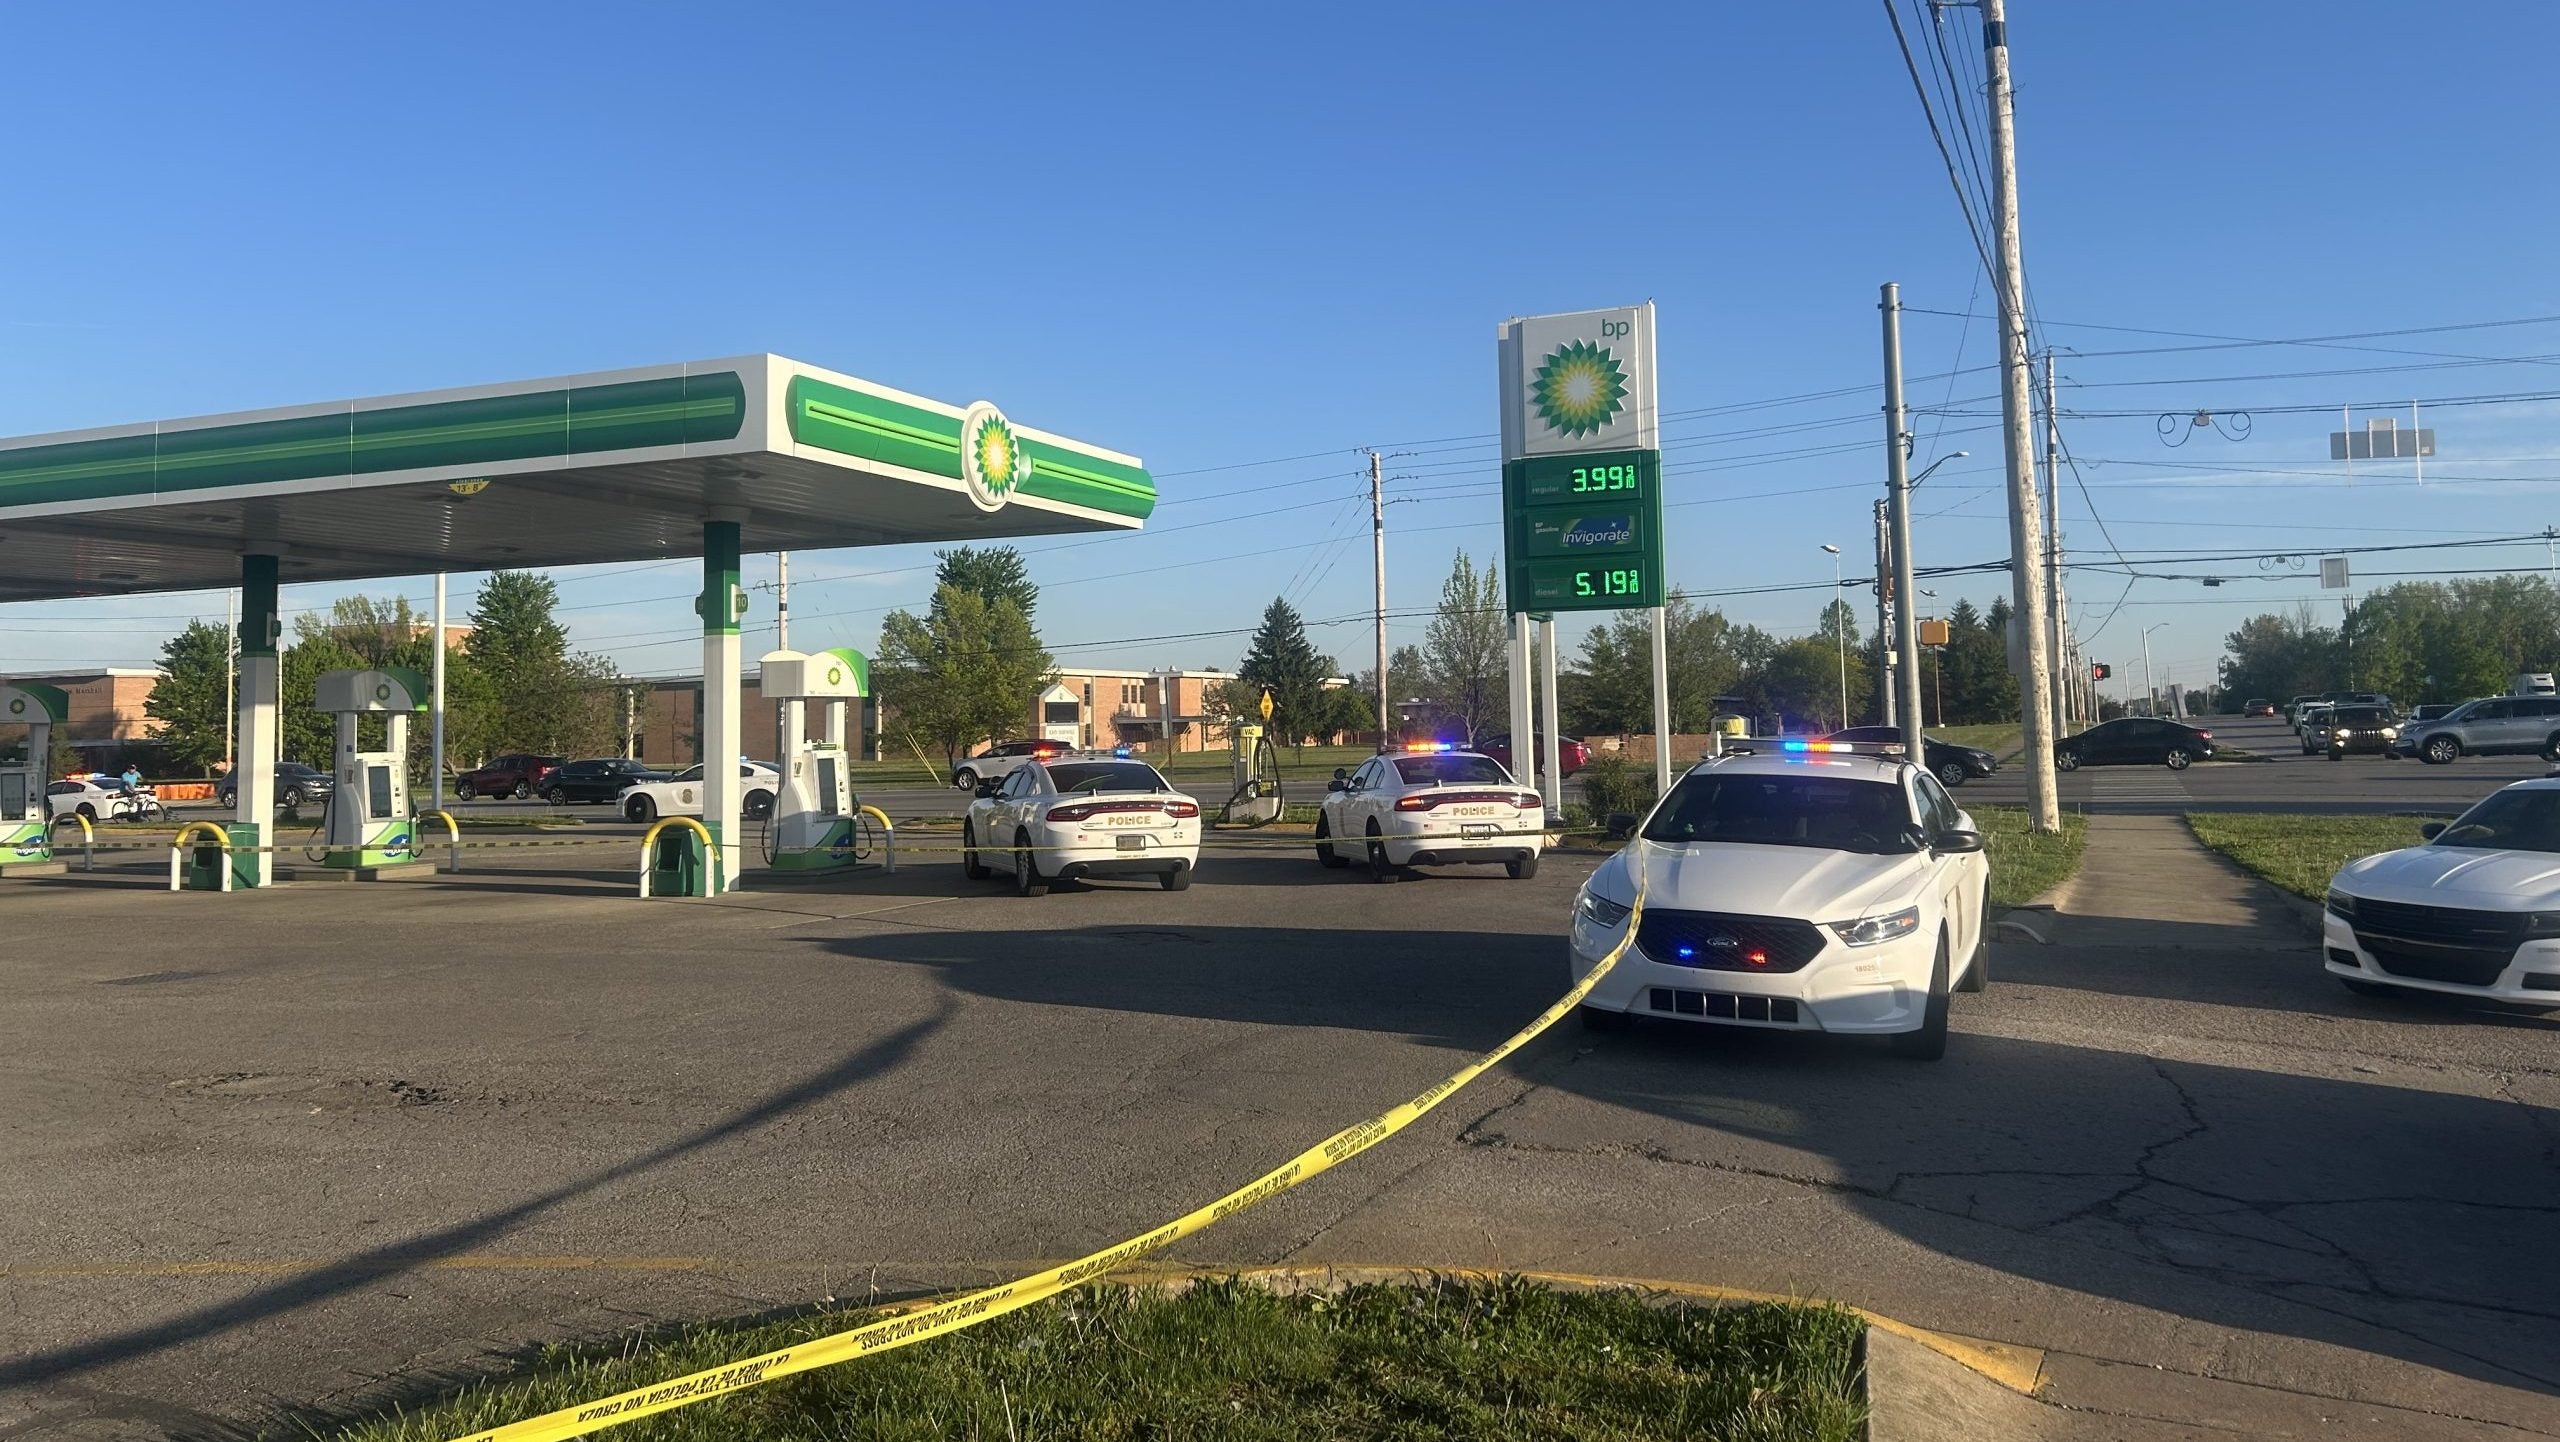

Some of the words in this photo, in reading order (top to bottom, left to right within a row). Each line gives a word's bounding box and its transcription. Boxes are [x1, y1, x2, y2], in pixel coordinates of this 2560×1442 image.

[1601, 318, 1629, 340] bp
[1573, 466, 1623, 492] 3.99
[1576, 570, 1627, 595] 5.19
[736, 597, 746, 608] 10
[1452, 806, 1495, 816] POLICE
[1108, 816, 1151, 826] POLICE
[999, 1288, 1013, 1300] LA
[737, 1358, 773, 1377] LINEA
[774, 1354, 790, 1367] LA
[700, 1375, 717, 1388] LA
[720, 1369, 736, 1381] DE
[648, 1379, 698, 1403] POLICIA
[623, 1395, 646, 1411] NO
[577, 1401, 622, 1423] CRUZA
